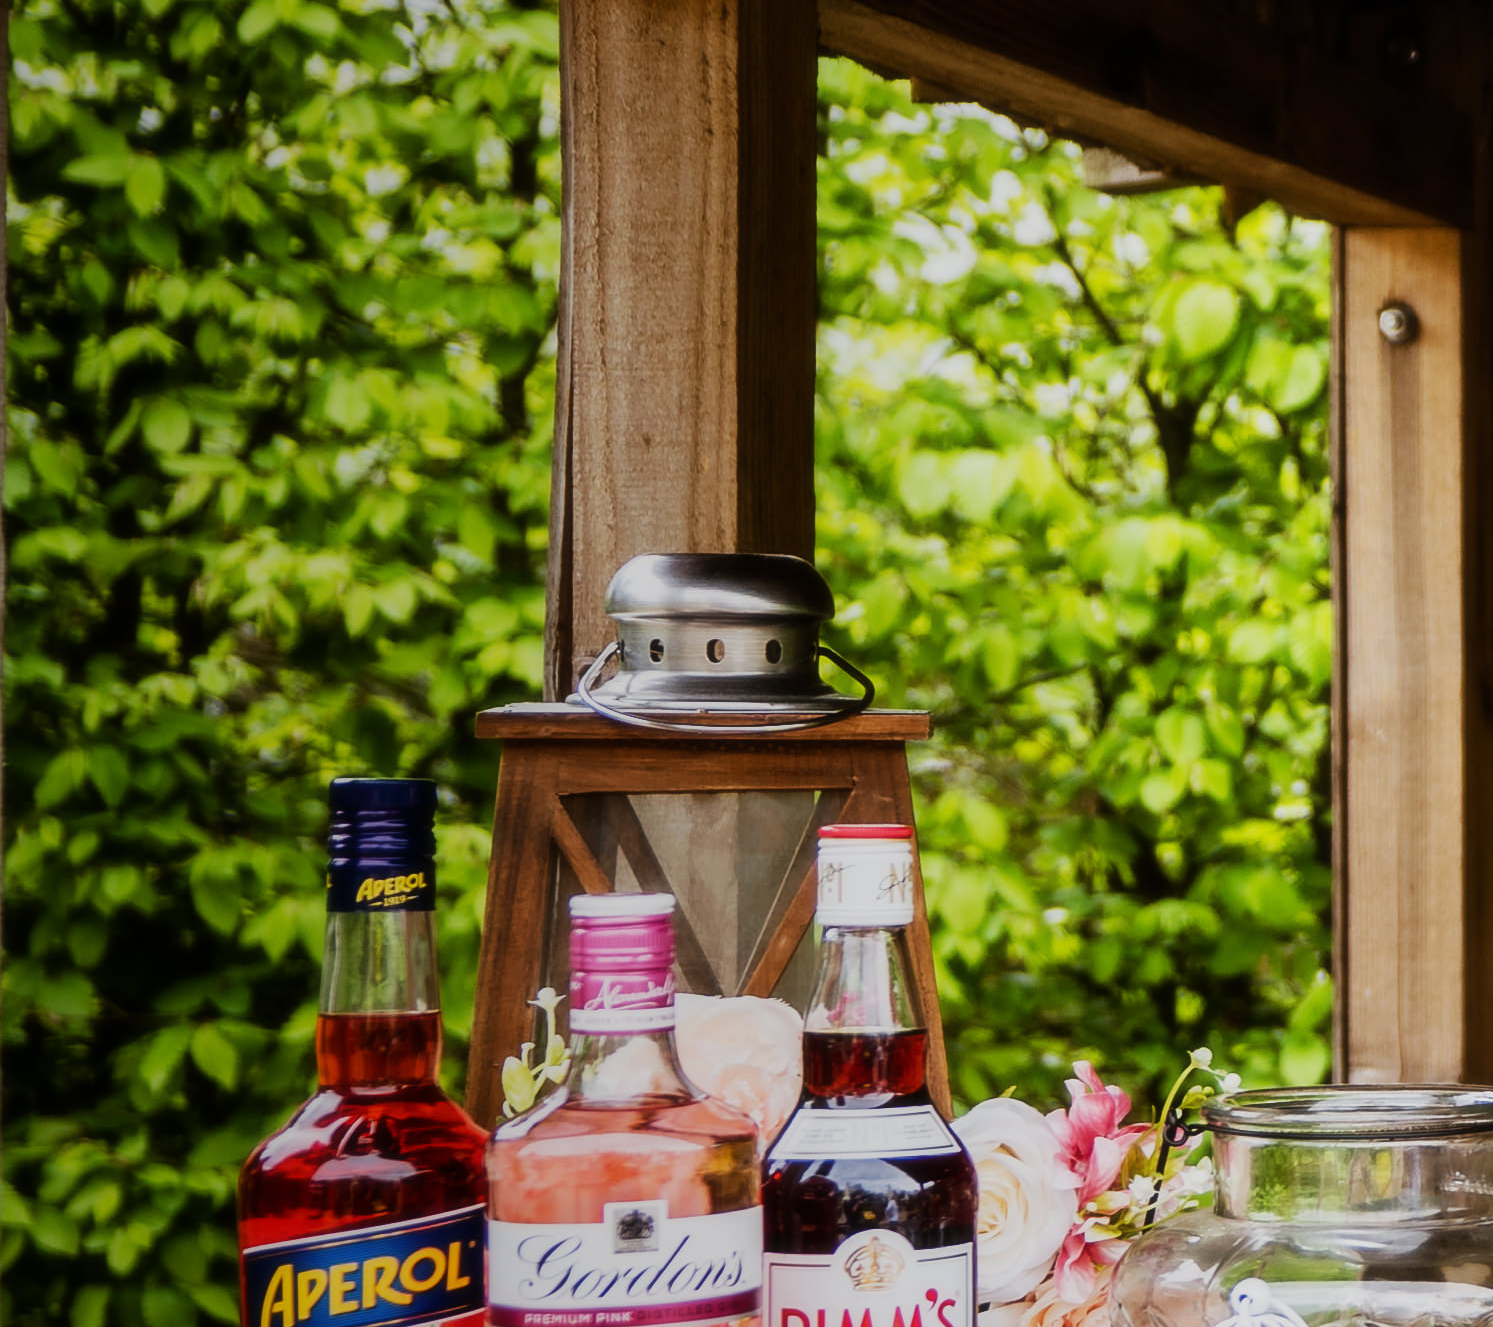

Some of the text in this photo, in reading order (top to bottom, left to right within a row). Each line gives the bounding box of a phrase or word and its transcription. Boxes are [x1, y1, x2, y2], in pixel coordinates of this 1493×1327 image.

[355, 872, 428, 903] APEROL
[383, 895, 408, 907] 1919
[516, 1234, 742, 1301] Gordon's
[524, 1313, 594, 1325] PREMIUM
[595, 1312, 634, 1324] PINK
